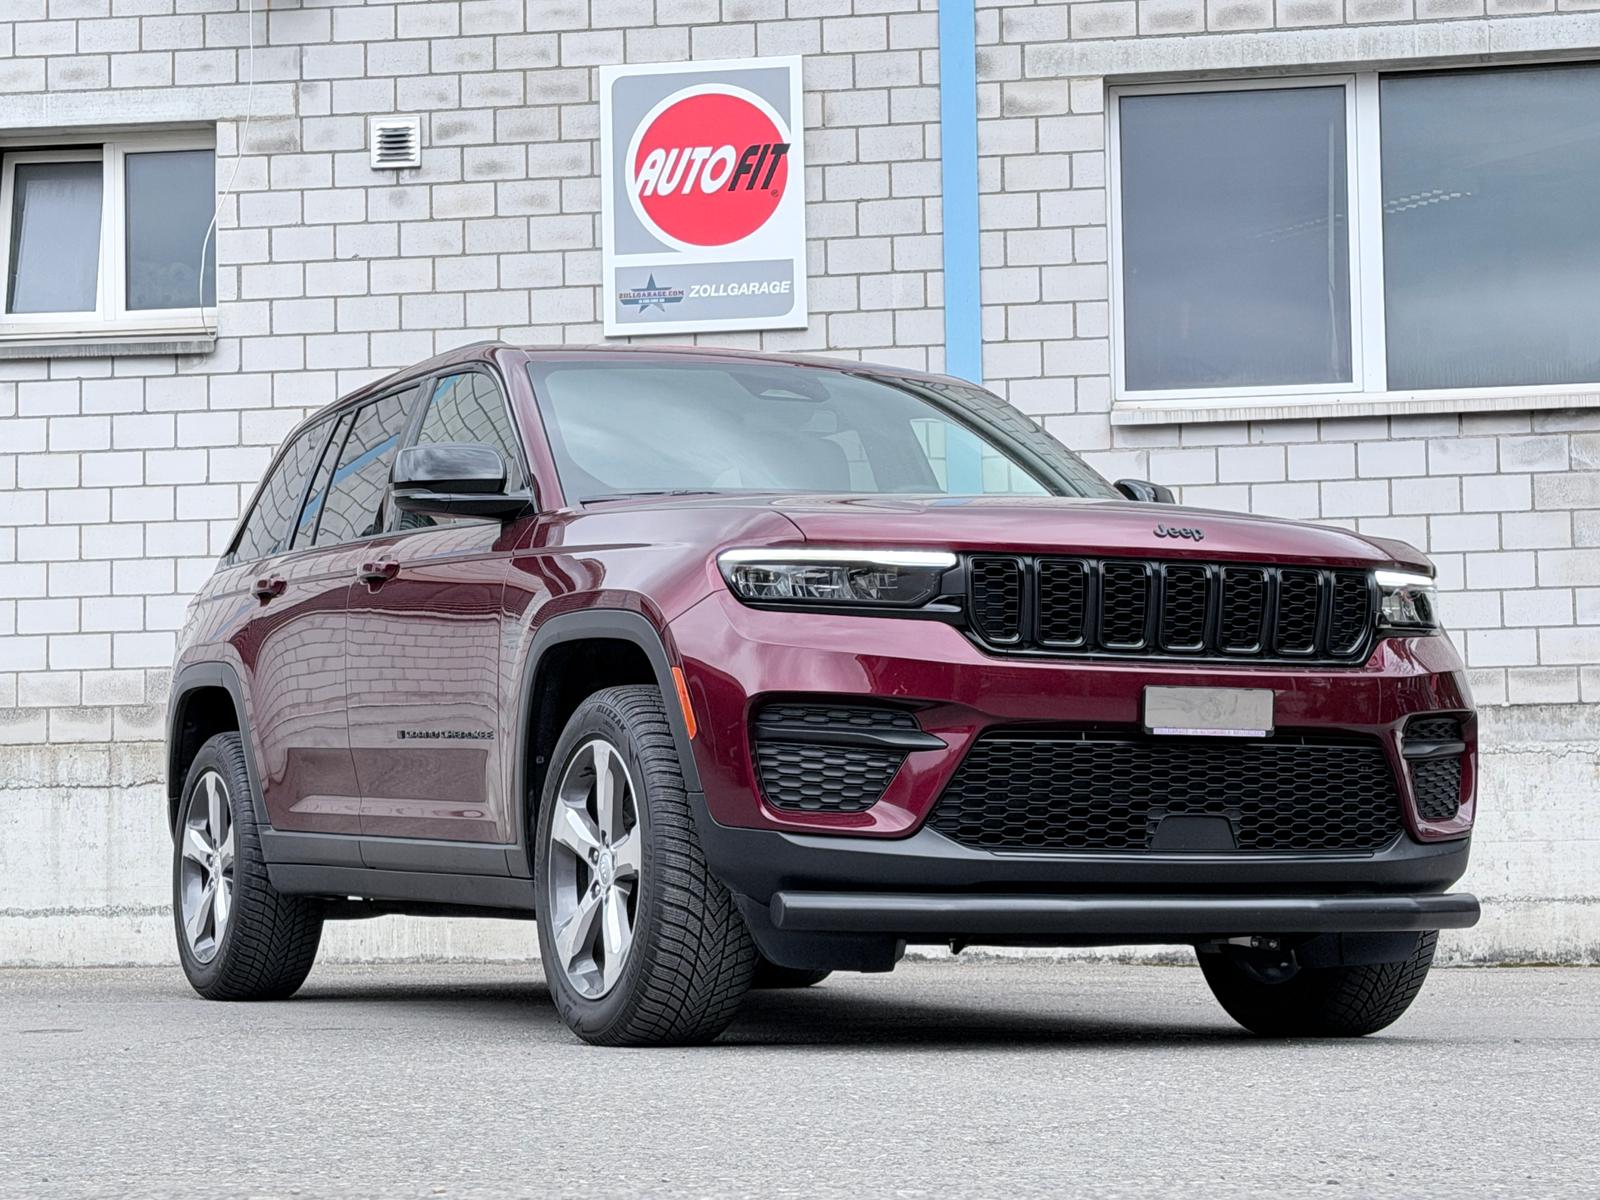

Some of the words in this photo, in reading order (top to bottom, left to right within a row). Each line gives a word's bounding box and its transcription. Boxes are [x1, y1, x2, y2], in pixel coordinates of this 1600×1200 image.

[635, 144, 791, 196] AUTOFIT
[689, 280, 792, 298] ZOLLGARAGE
[1153, 520, 1205, 542] Jeep
[596, 704, 626, 733] BLIZZAK
